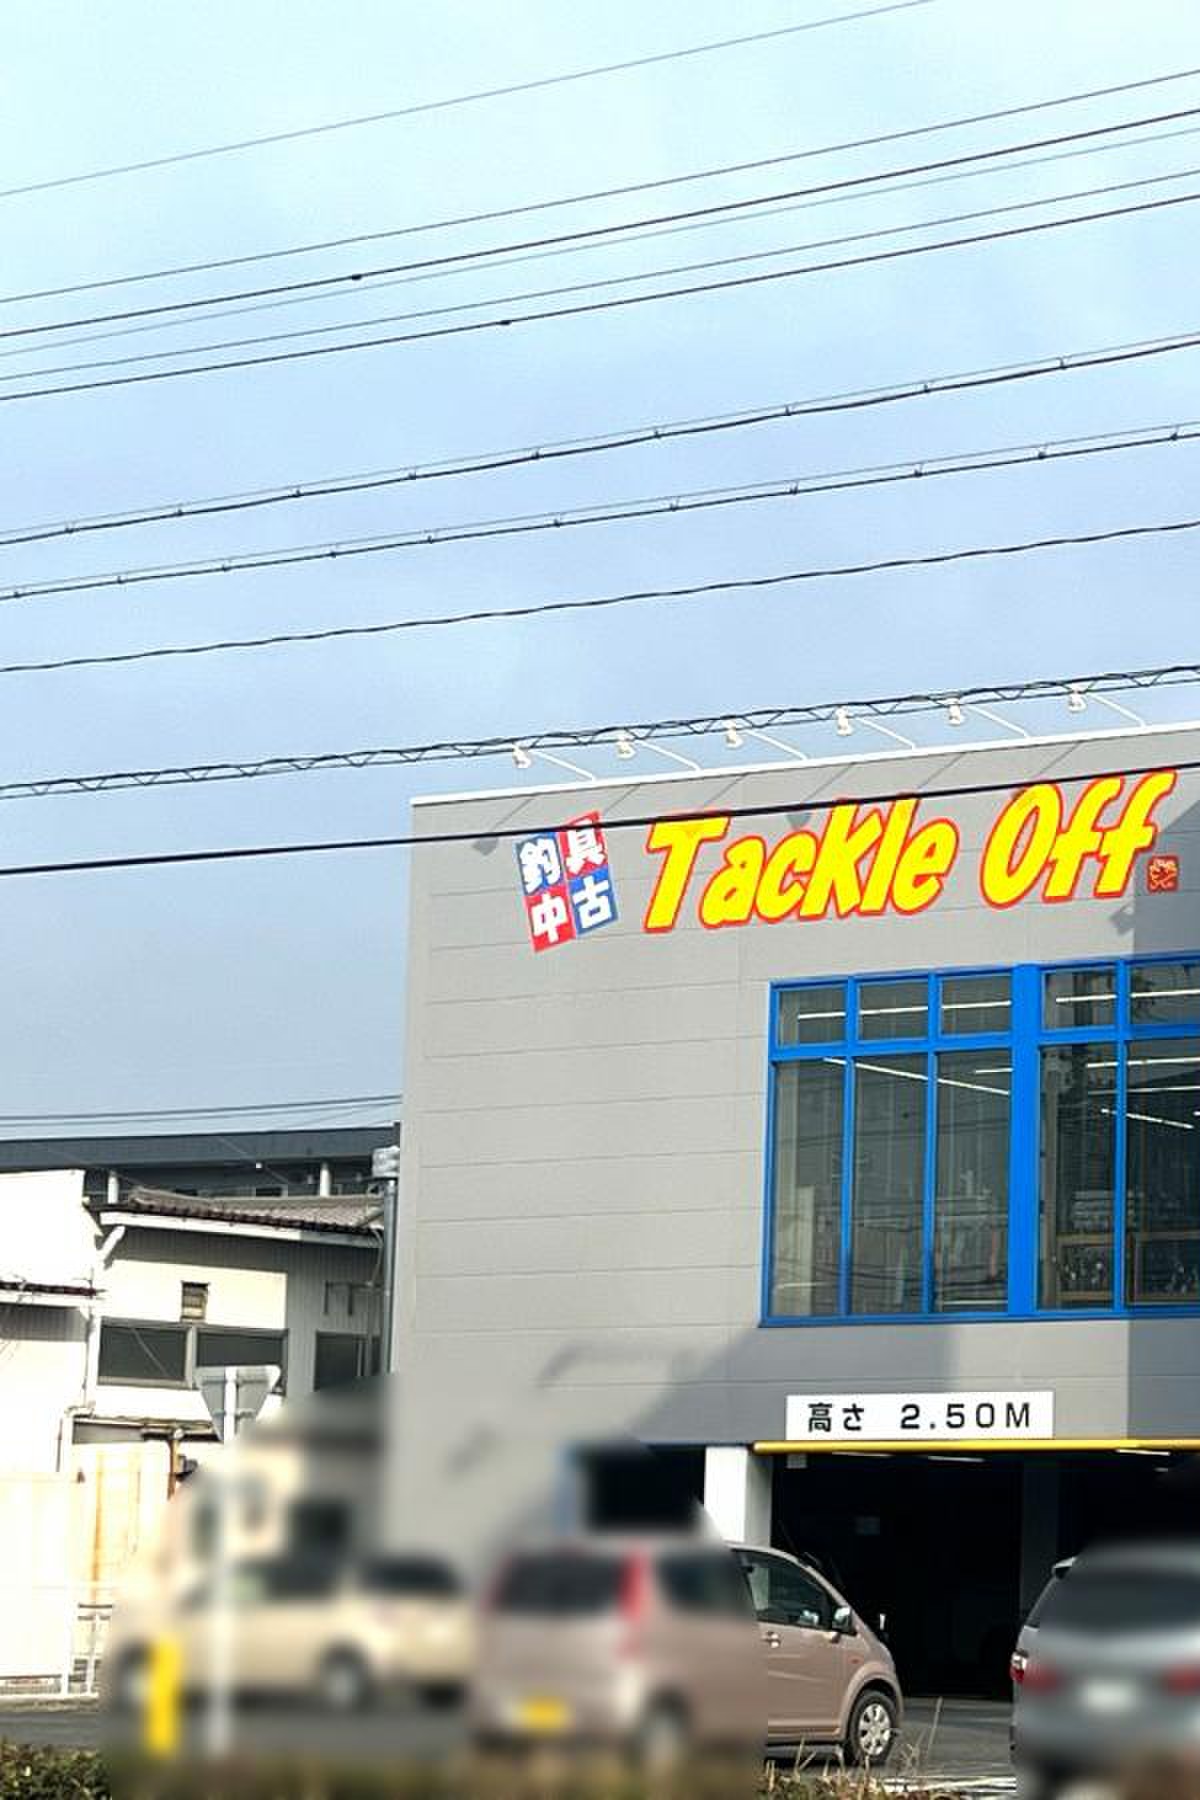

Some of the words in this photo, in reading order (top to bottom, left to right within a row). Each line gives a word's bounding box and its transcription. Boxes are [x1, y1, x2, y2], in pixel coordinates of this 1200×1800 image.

[519, 817, 606, 893] 釣具
[643, 795, 961, 934] Tackle
[979, 768, 1178, 911] Off
[531, 875, 612, 943] 中古
[808, 1402, 865, 1432] 高さ
[901, 1402, 1030, 1430] 2.50M
